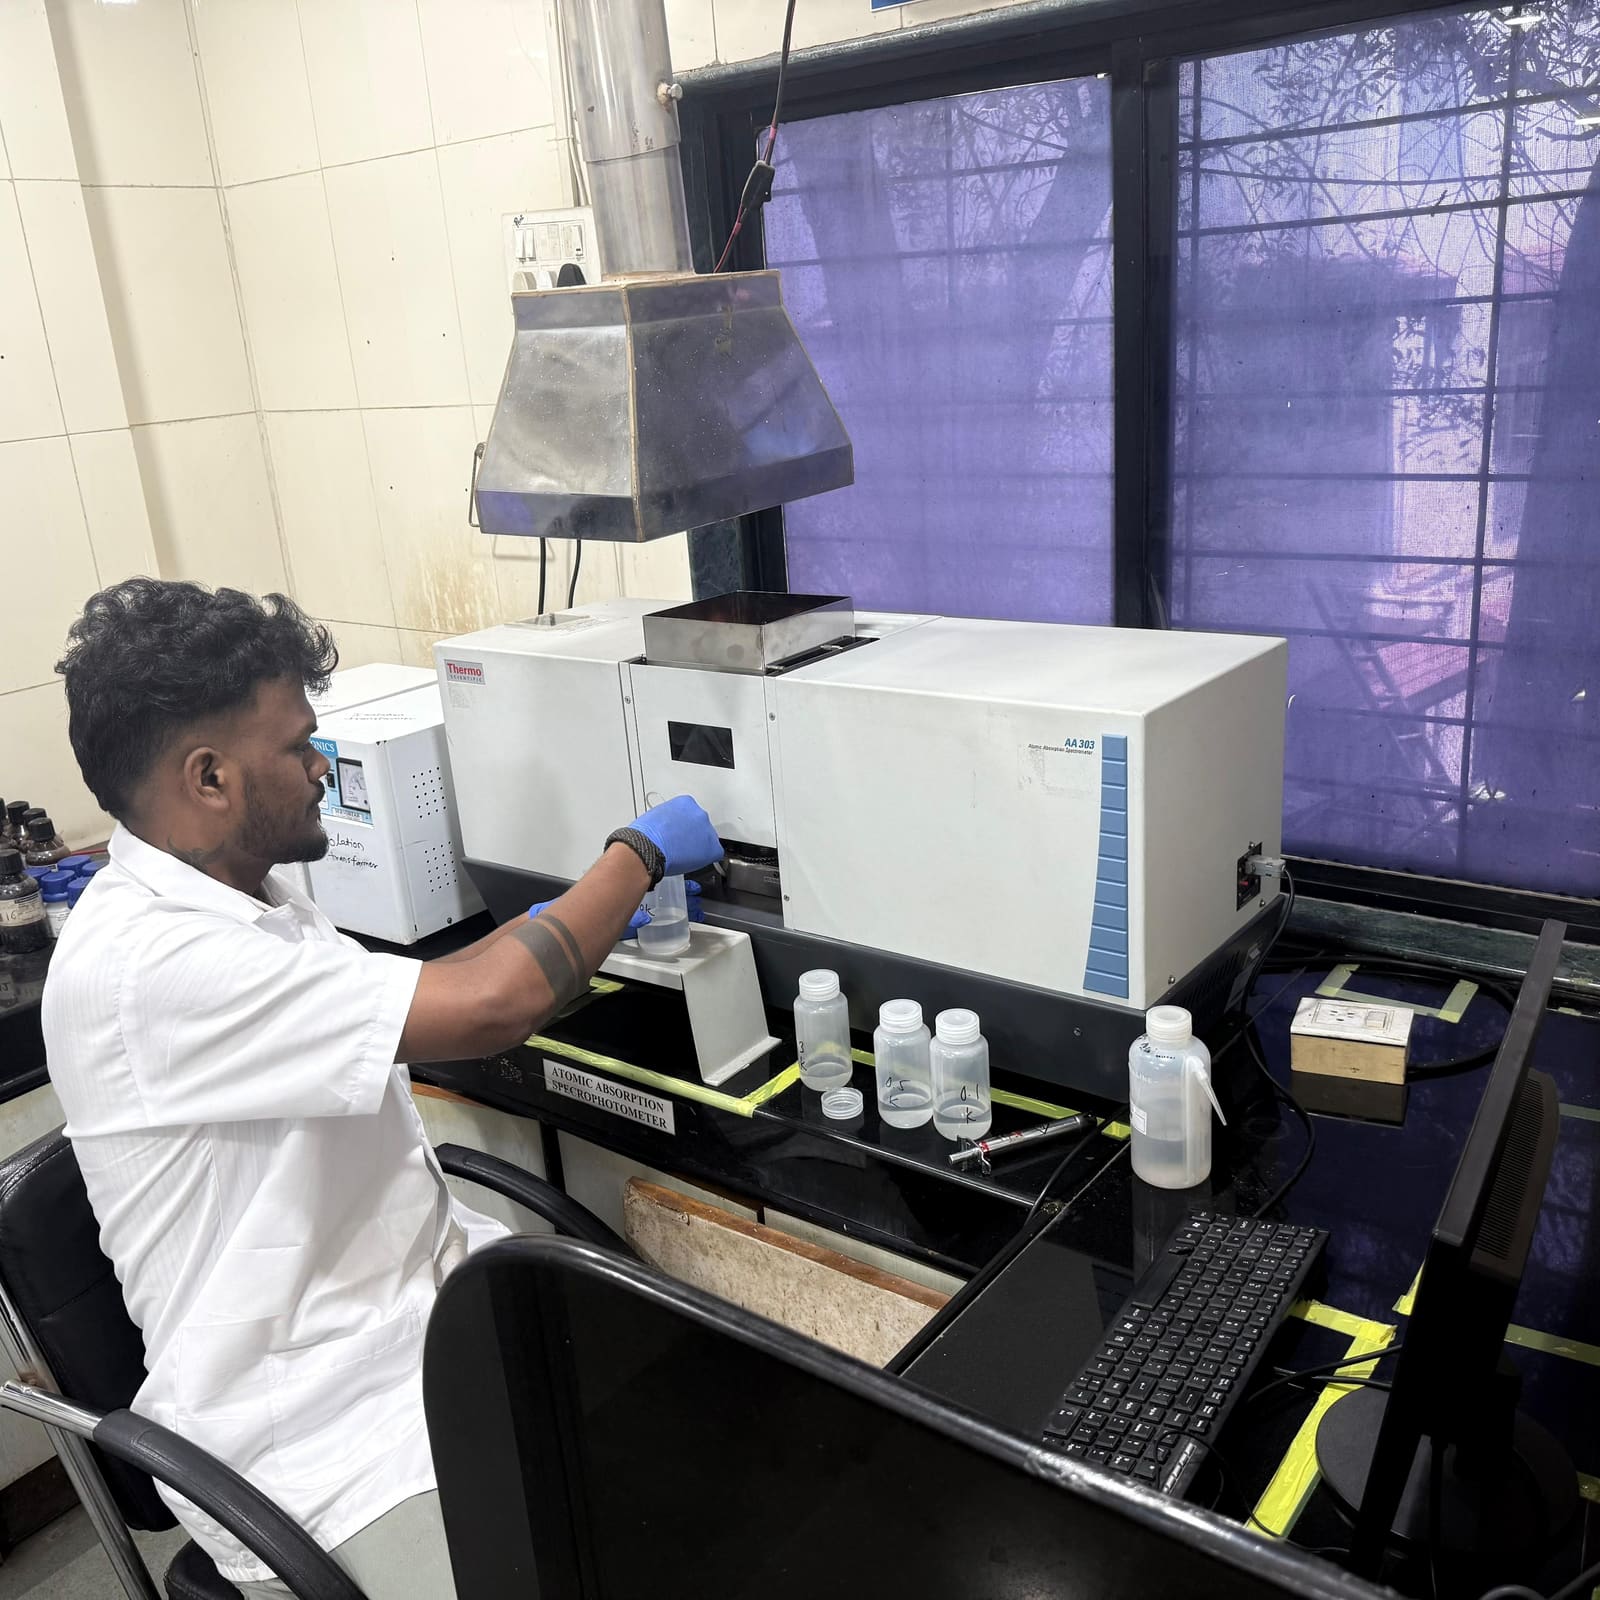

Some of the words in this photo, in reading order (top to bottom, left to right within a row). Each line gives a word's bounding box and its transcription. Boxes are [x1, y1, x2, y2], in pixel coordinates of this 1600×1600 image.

[447, 663, 482, 677] Thermo
[310, 740, 335, 753] ONICS
[1064, 738, 1077, 748] AA
[1079, 739, 1095, 749] 303
[329, 832, 365, 851] olation
[552, 1066, 593, 1089] ATOMIC
[595, 1081, 664, 1113] ABSORPTION
[552, 1080, 668, 1129] SPECROPHOTOMETER
